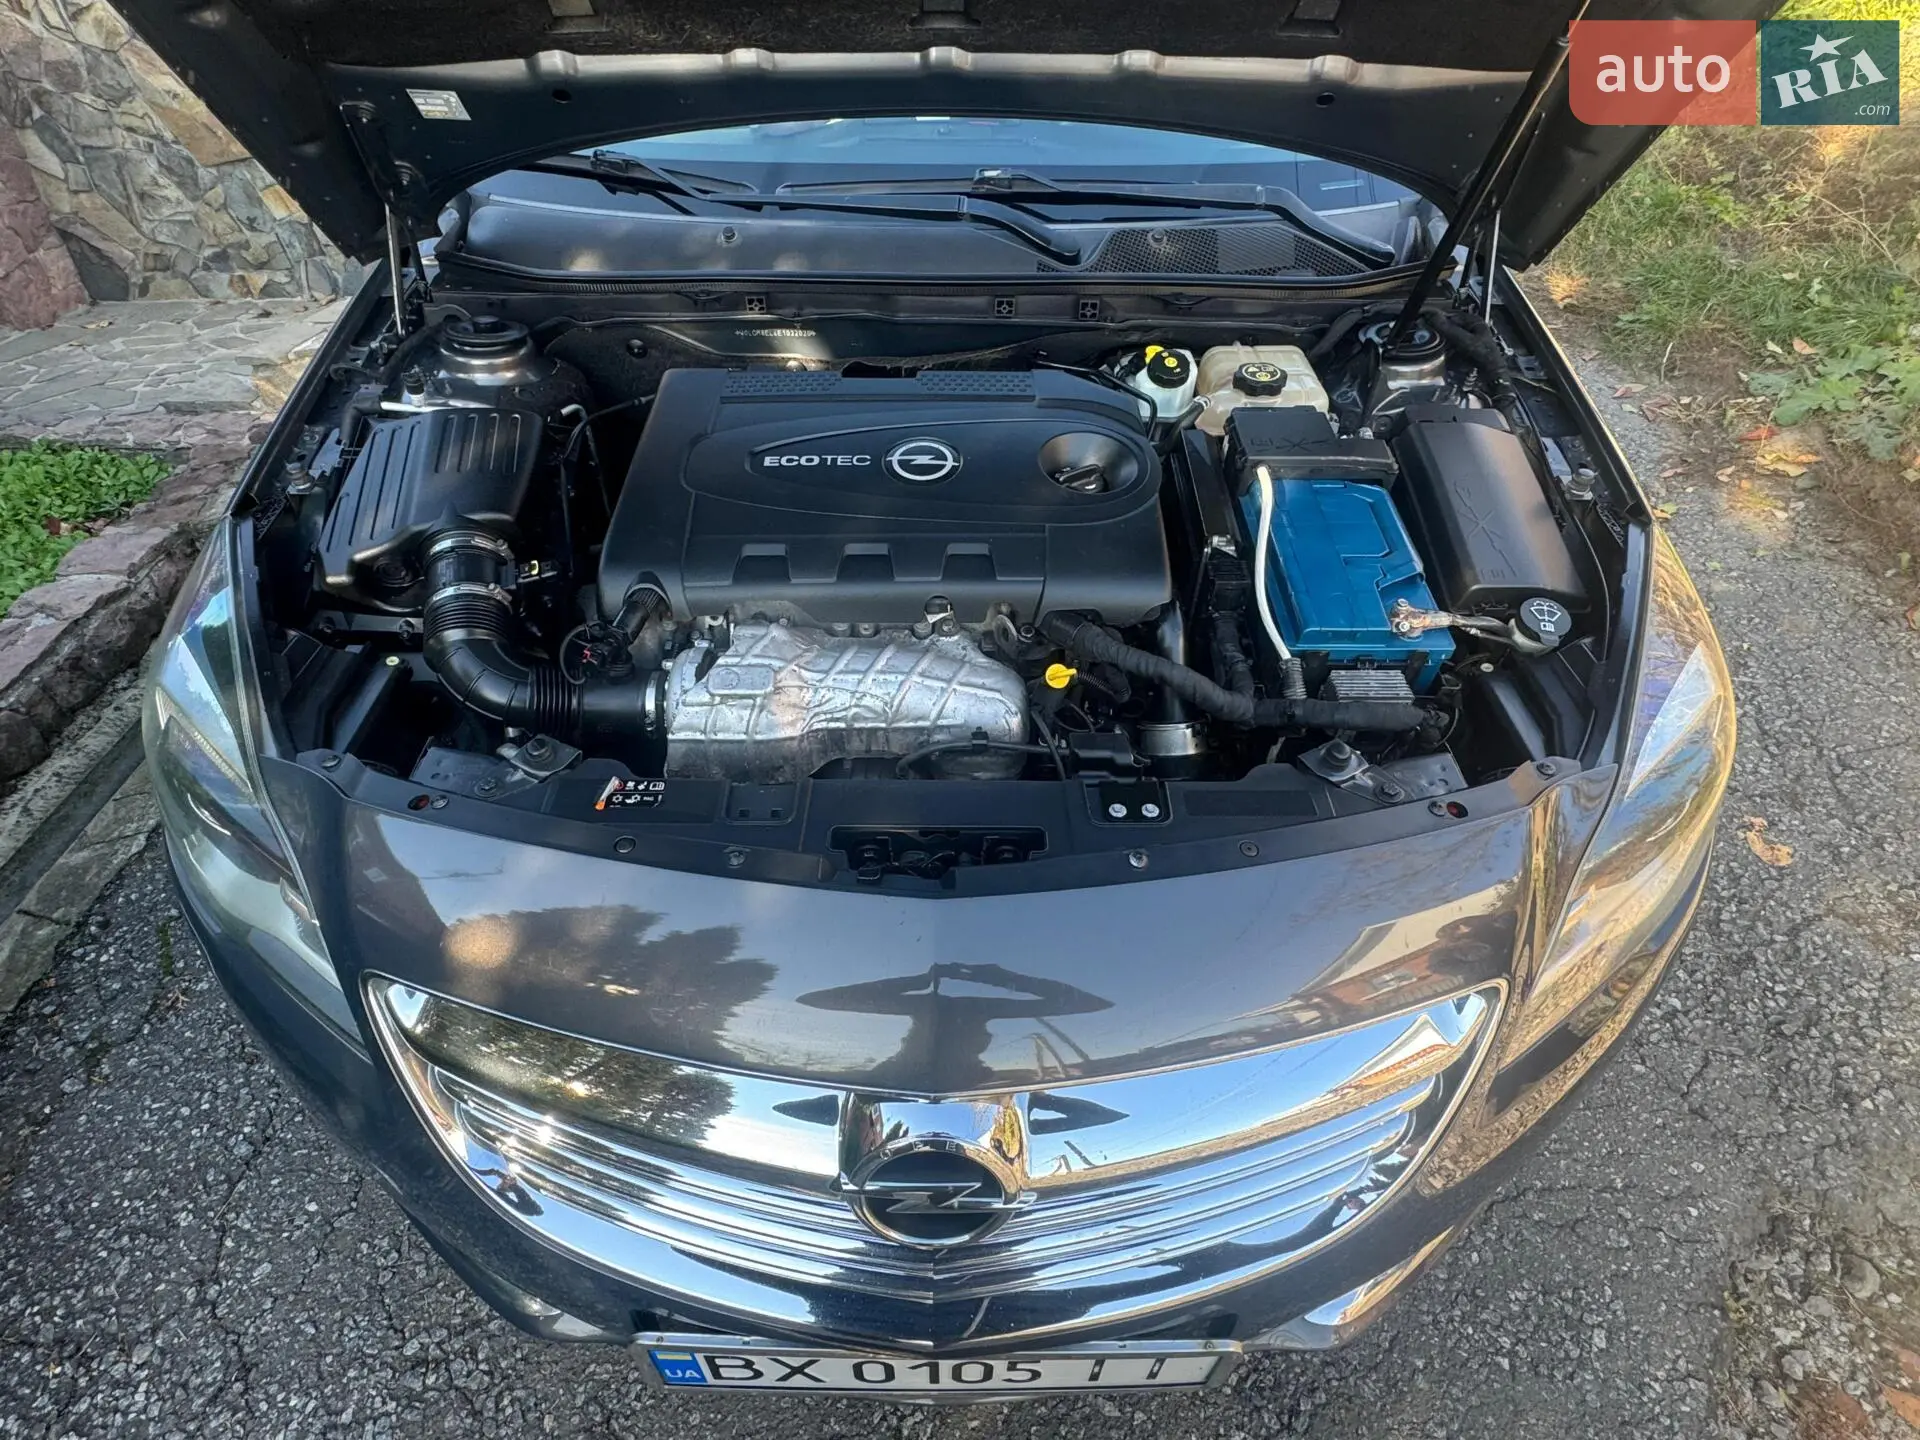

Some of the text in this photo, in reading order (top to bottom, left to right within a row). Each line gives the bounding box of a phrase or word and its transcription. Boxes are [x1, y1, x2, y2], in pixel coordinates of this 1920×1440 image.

[763, 455, 871, 467] ECOTEC
[664, 1369, 702, 1379] UA
[703, 1355, 827, 1383] BX
[852, 1360, 1042, 1385] 0105
